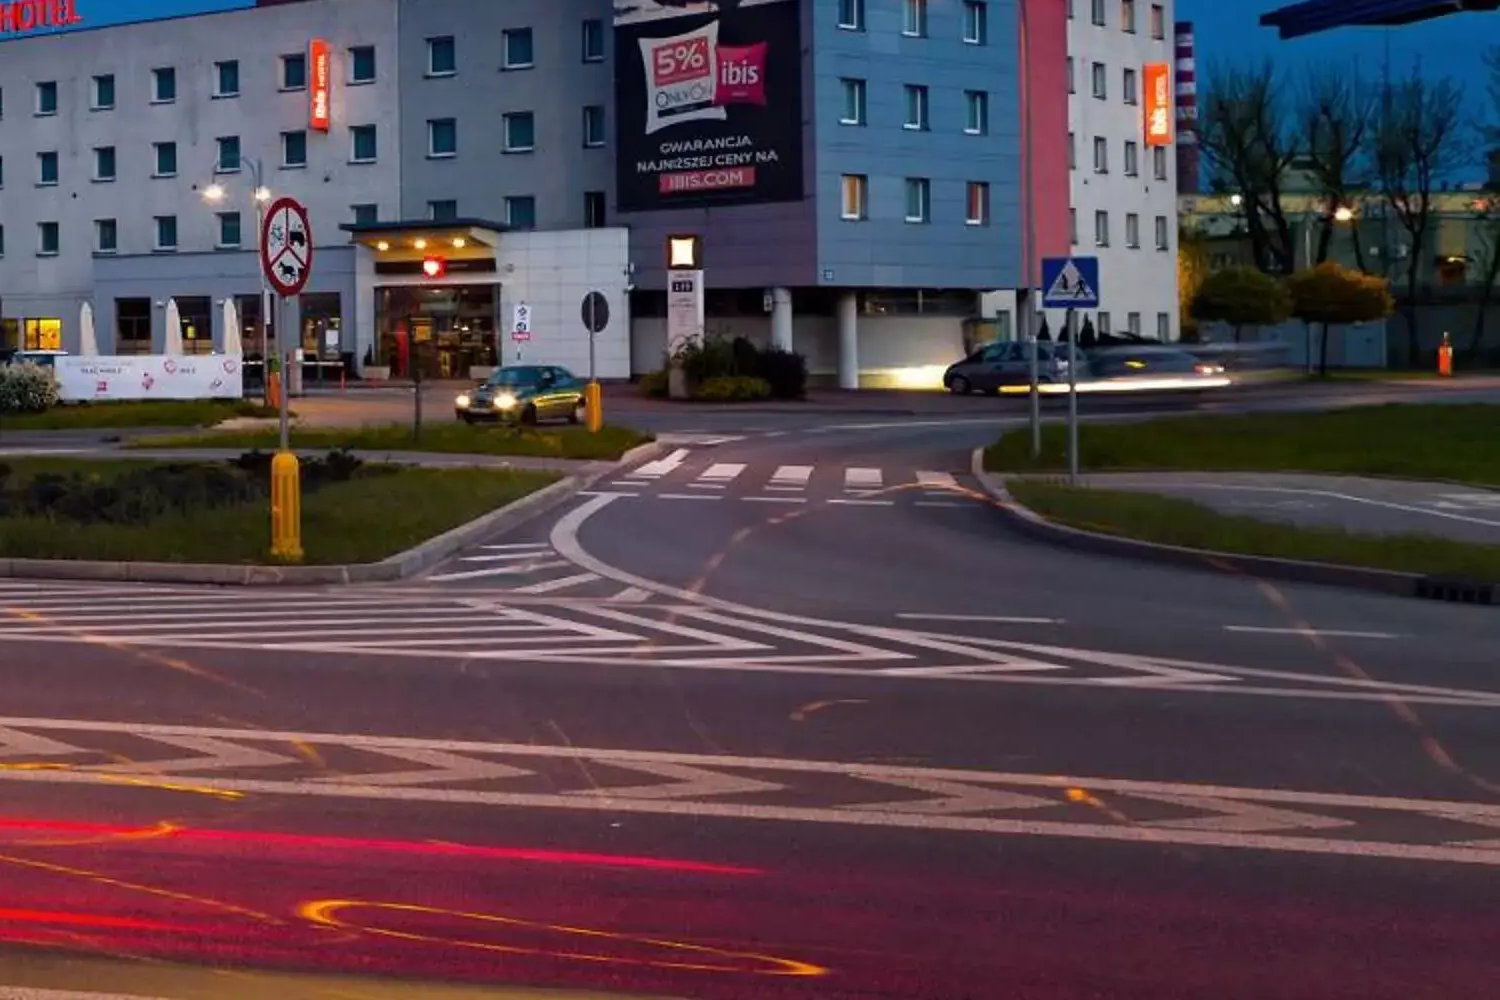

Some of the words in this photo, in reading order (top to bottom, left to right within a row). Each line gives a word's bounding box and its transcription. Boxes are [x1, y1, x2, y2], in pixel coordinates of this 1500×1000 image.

[721, 59, 759, 85] ibis
[659, 135, 752, 155] GWARANCJA
[715, 152, 753, 166] CENY
[755, 149, 779, 163] NA
